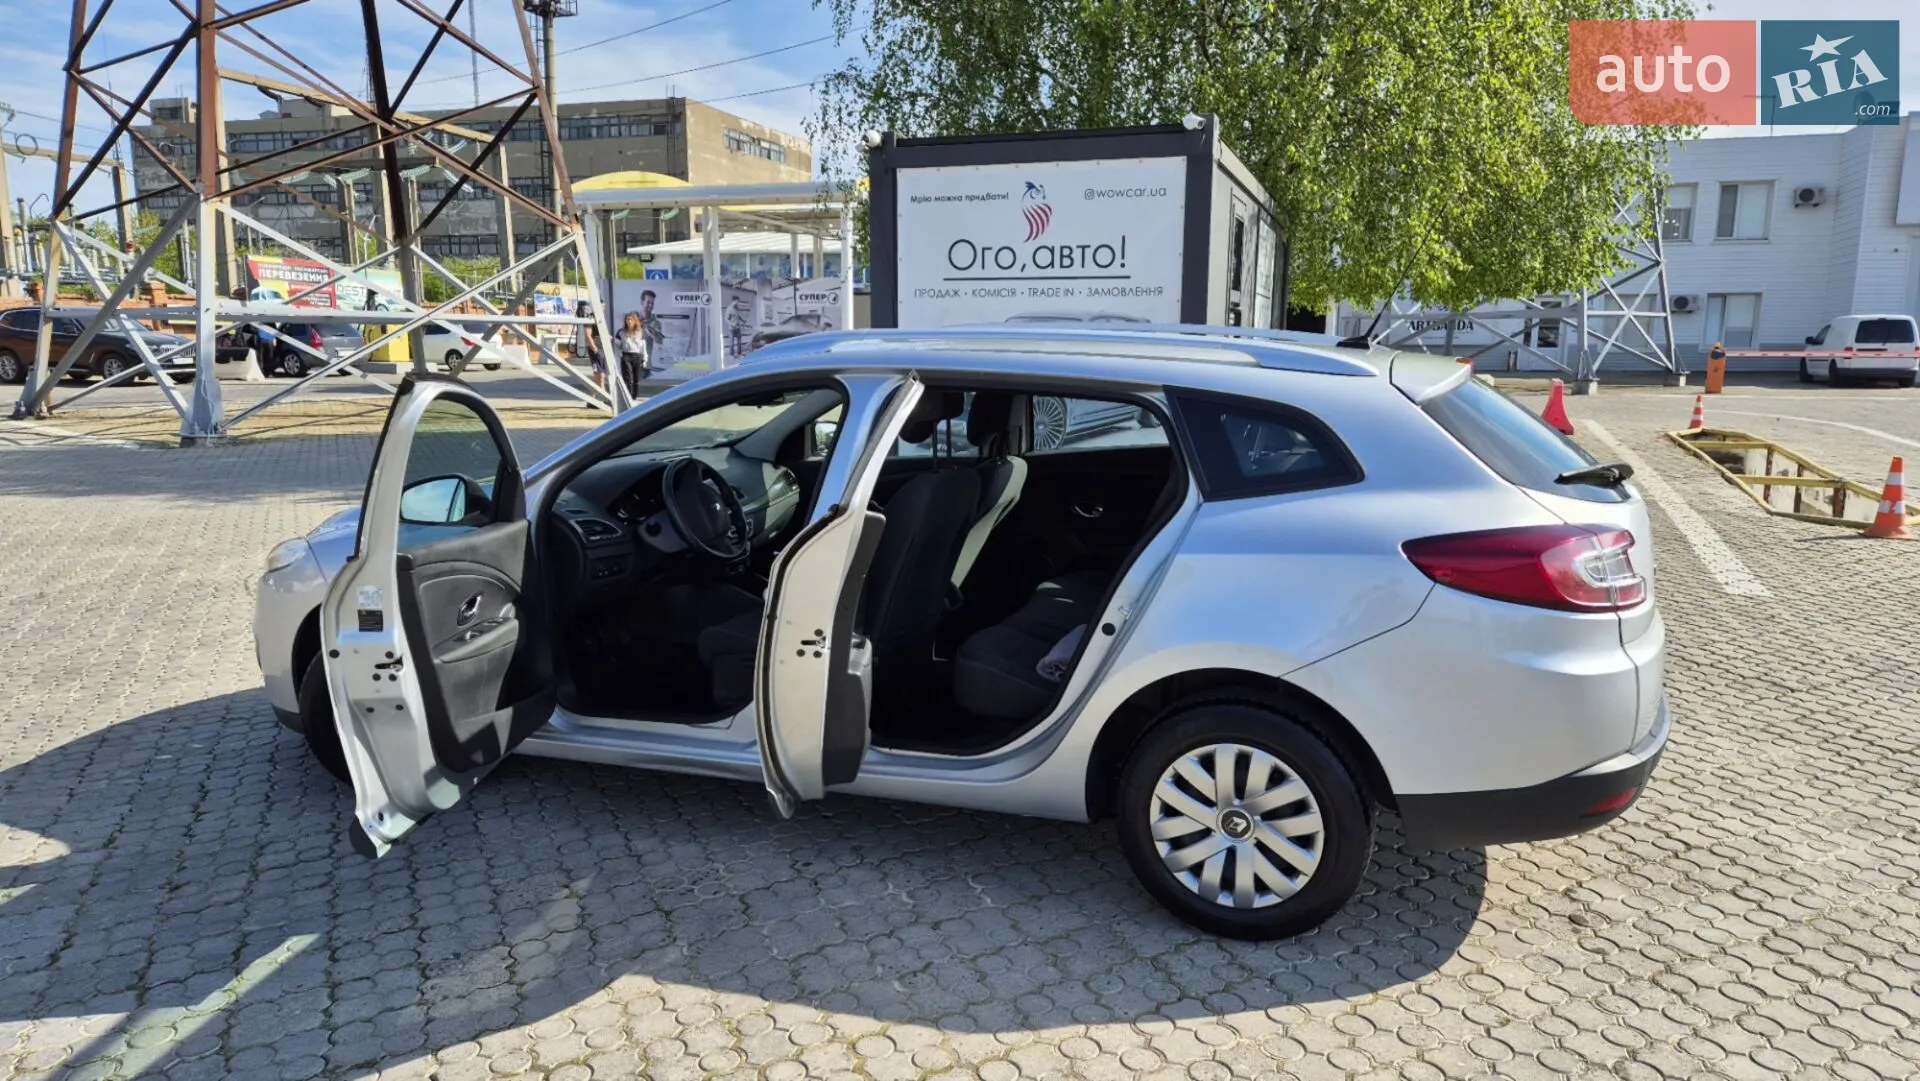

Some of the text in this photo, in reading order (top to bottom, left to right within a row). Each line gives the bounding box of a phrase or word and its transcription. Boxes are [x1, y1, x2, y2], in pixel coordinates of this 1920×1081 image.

[910, 191, 1010, 204] Мрію можна придбати!
[258, 268, 330, 285] ПЕРЕВЕЗЕННЯ
[674, 294, 701, 302] СУПЕР
[799, 293, 827, 301] СУПЕР
[914, 286, 1163, 299] ПРОДАЖ КОМІСІЯ TRADE IN ЗАМОВЛЕННЯ
[1408, 319, 1474, 331] ARTSADA
